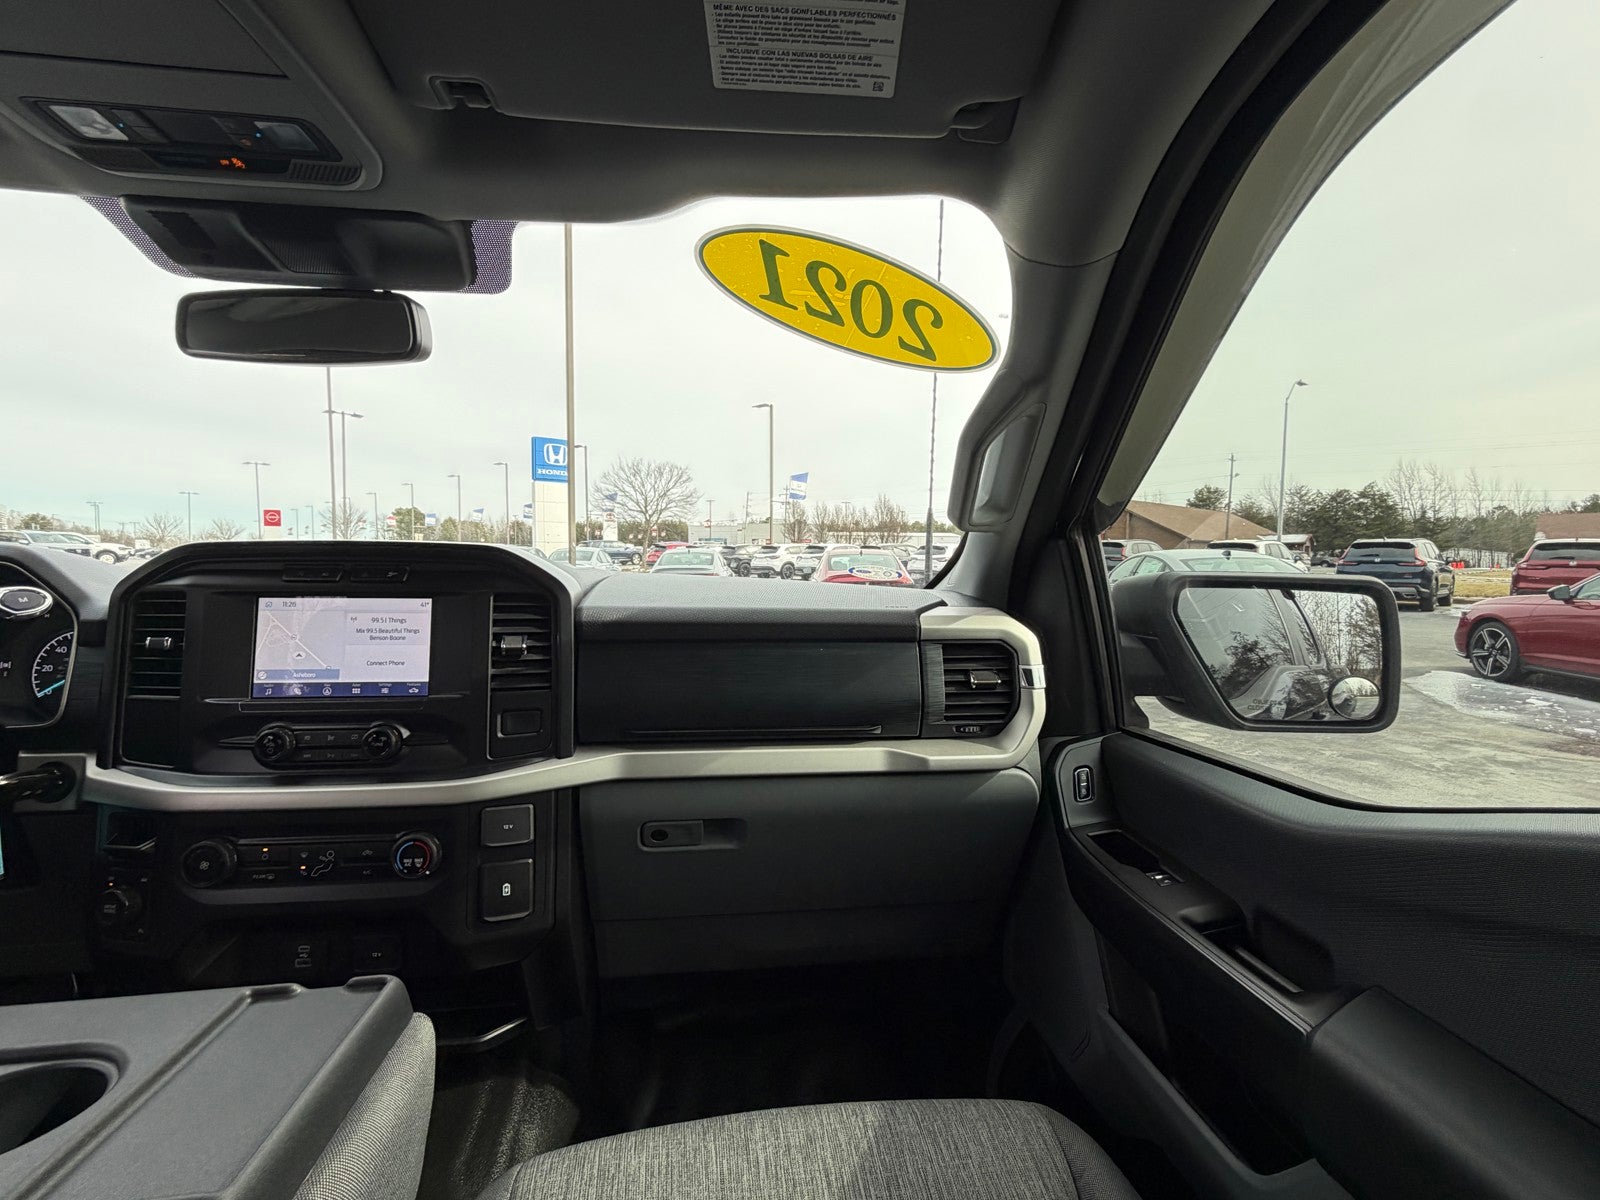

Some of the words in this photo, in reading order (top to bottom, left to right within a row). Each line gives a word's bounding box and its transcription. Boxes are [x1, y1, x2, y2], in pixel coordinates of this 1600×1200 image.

[755, 5, 769, 13] DES
[771, 6, 789, 14] SACS
[791, 7, 837, 16] GONFLABLES
[839, 10, 896, 20] PERFECTIONNÉS
[537, 468, 568, 476] HOND
[388, 616, 407, 624] Things
[402, 627, 420, 635] Things
[41, 664, 53, 672] 20
